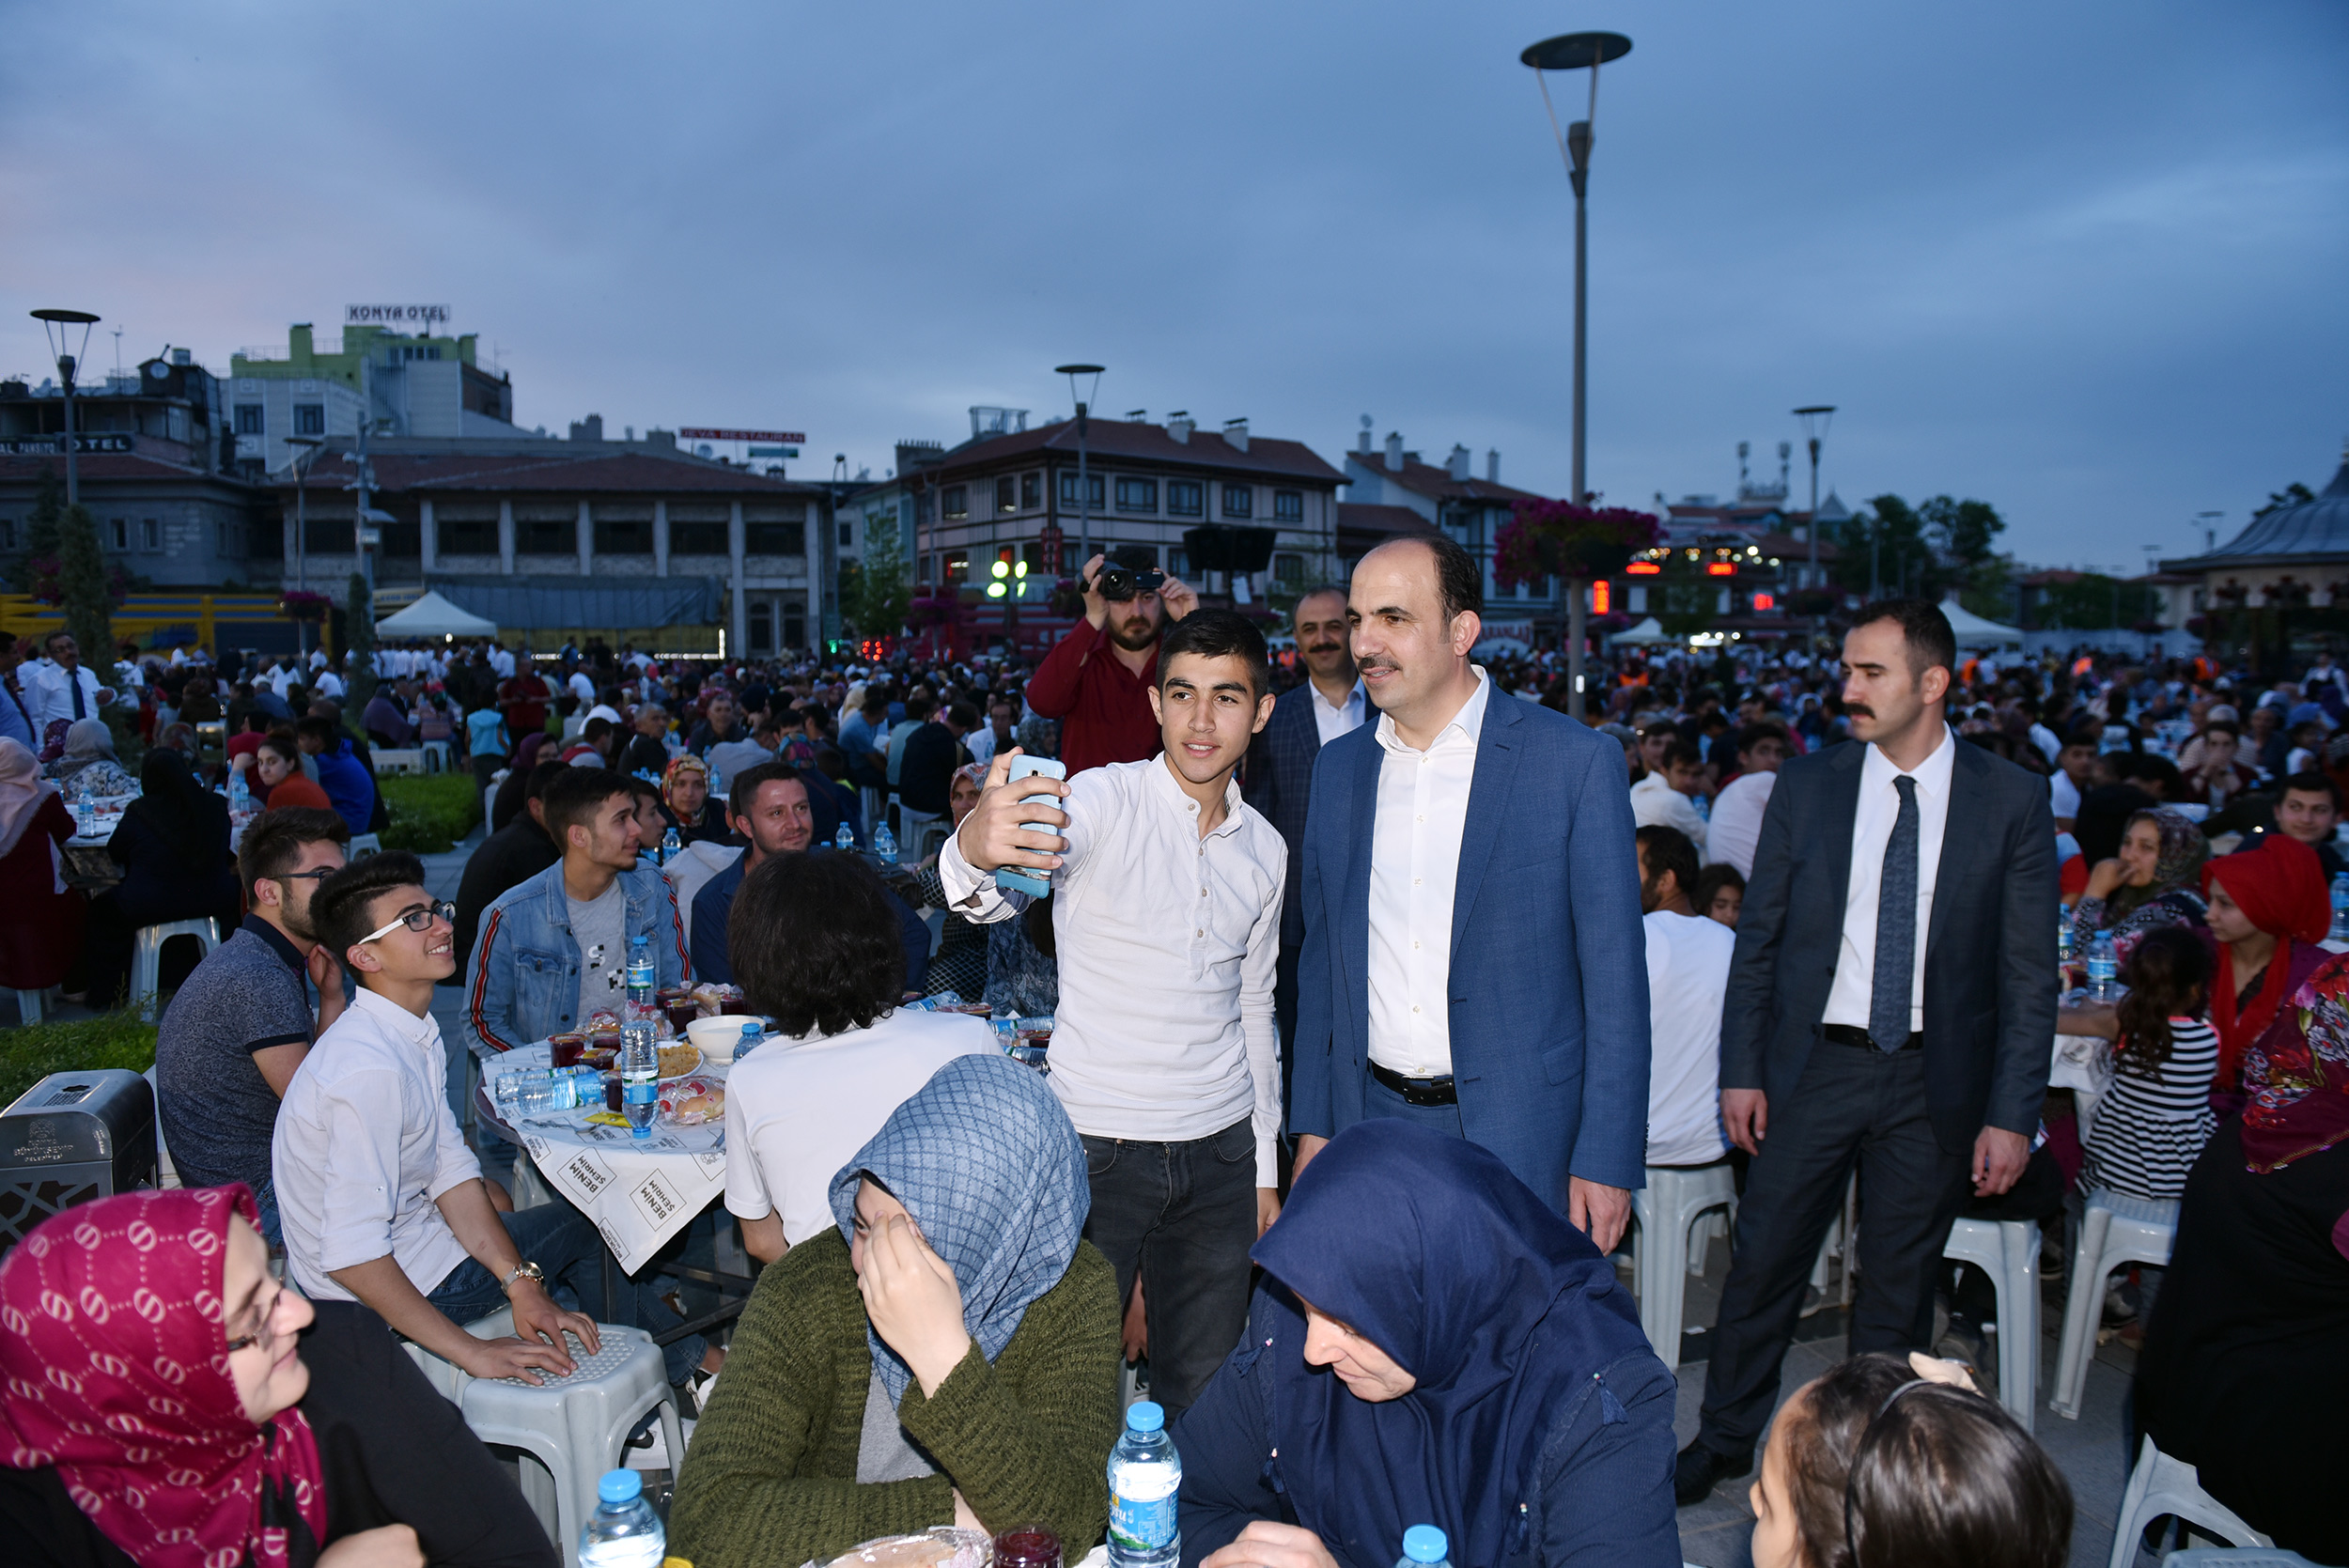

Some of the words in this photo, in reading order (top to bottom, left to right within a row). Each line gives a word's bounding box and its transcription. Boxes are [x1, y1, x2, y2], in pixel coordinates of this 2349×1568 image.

[350, 305, 402, 320] KONYA
[407, 305, 446, 321] OTEL
[568, 1162, 599, 1193] BENİM
[577, 1155, 606, 1185] ŞEHRİM
[641, 1187, 667, 1219] BENİM
[648, 1180, 676, 1212] ŞEHRİM
